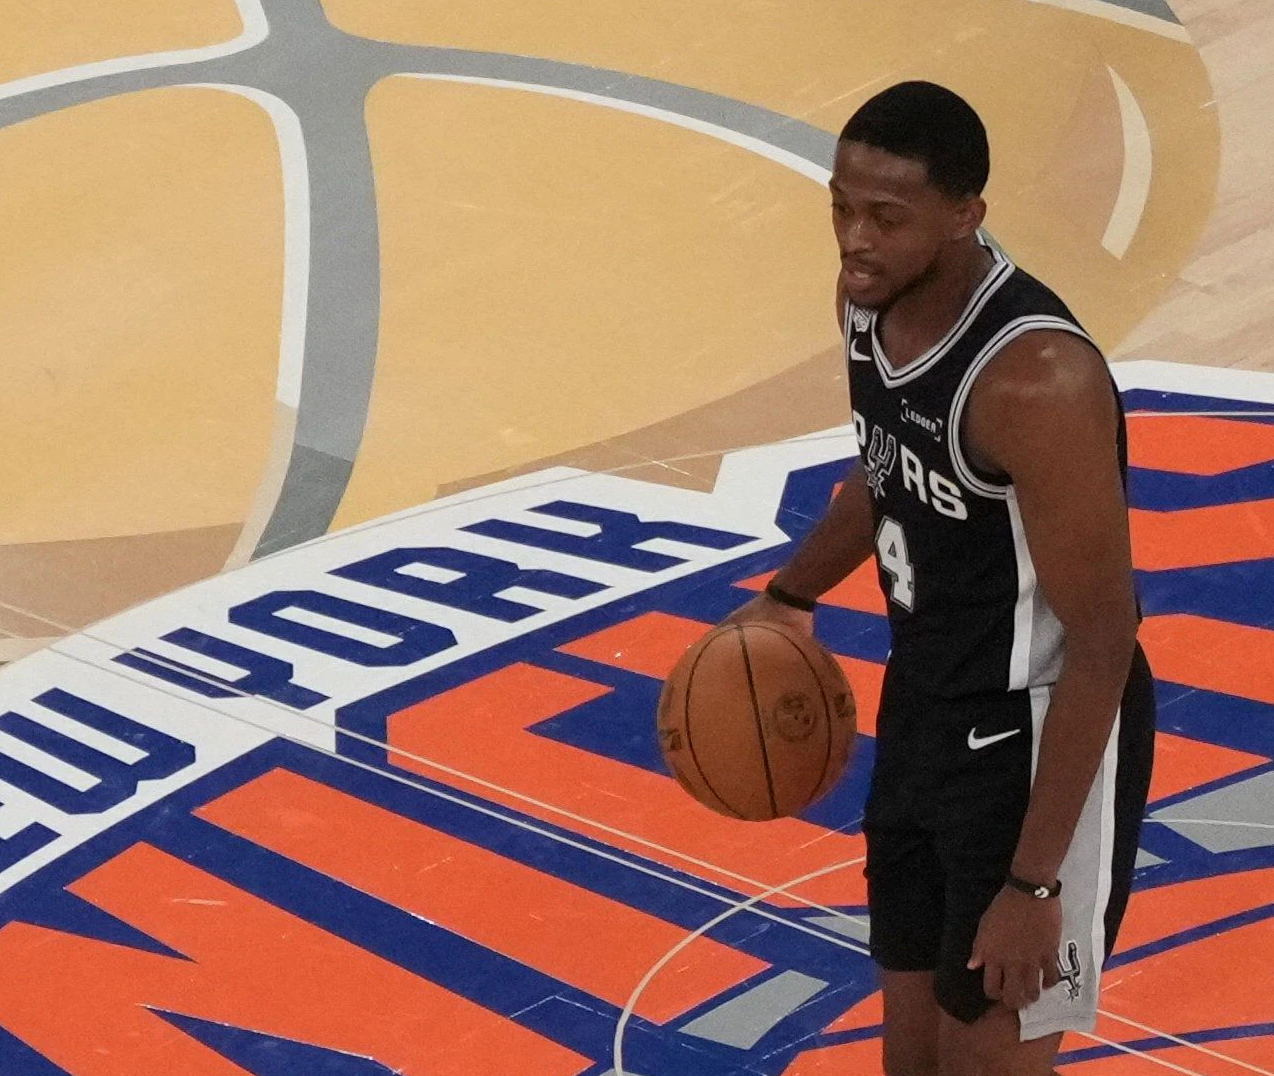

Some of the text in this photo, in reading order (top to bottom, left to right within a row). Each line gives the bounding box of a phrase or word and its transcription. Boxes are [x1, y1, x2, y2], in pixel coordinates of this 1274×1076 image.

[903, 404, 939, 436] LEDGER
[110, 499, 761, 711] YORK
[876, 516, 914, 613] 4
